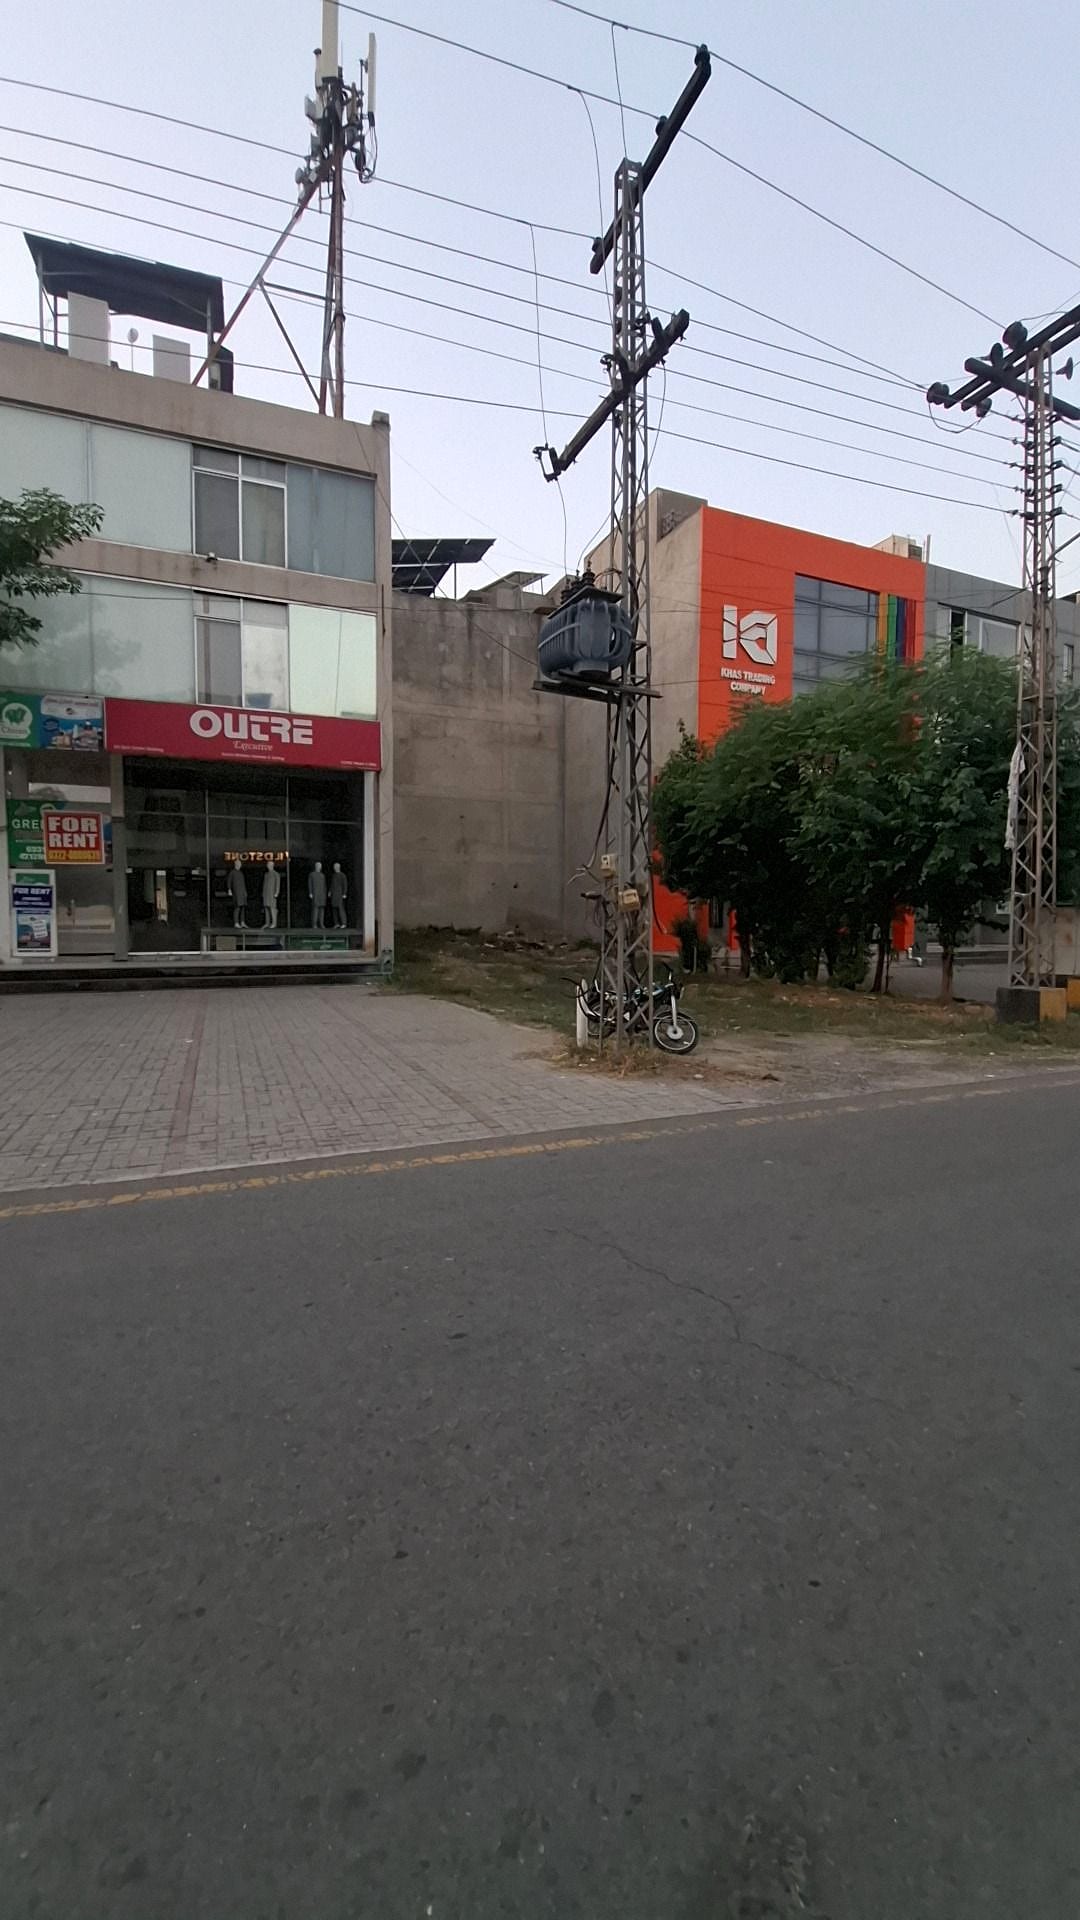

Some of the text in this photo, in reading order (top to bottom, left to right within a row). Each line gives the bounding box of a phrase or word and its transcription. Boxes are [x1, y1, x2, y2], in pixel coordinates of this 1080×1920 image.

[720, 667, 775, 684] KHAS TRADING
[730, 681, 766, 695] COMPANY
[189, 709, 313, 745] OUTRE
[11, 818, 44, 830] GRE
[47, 816, 98, 832] FOR
[48, 832, 98, 848] RENT
[13, 887, 51, 896] FOR RENT
